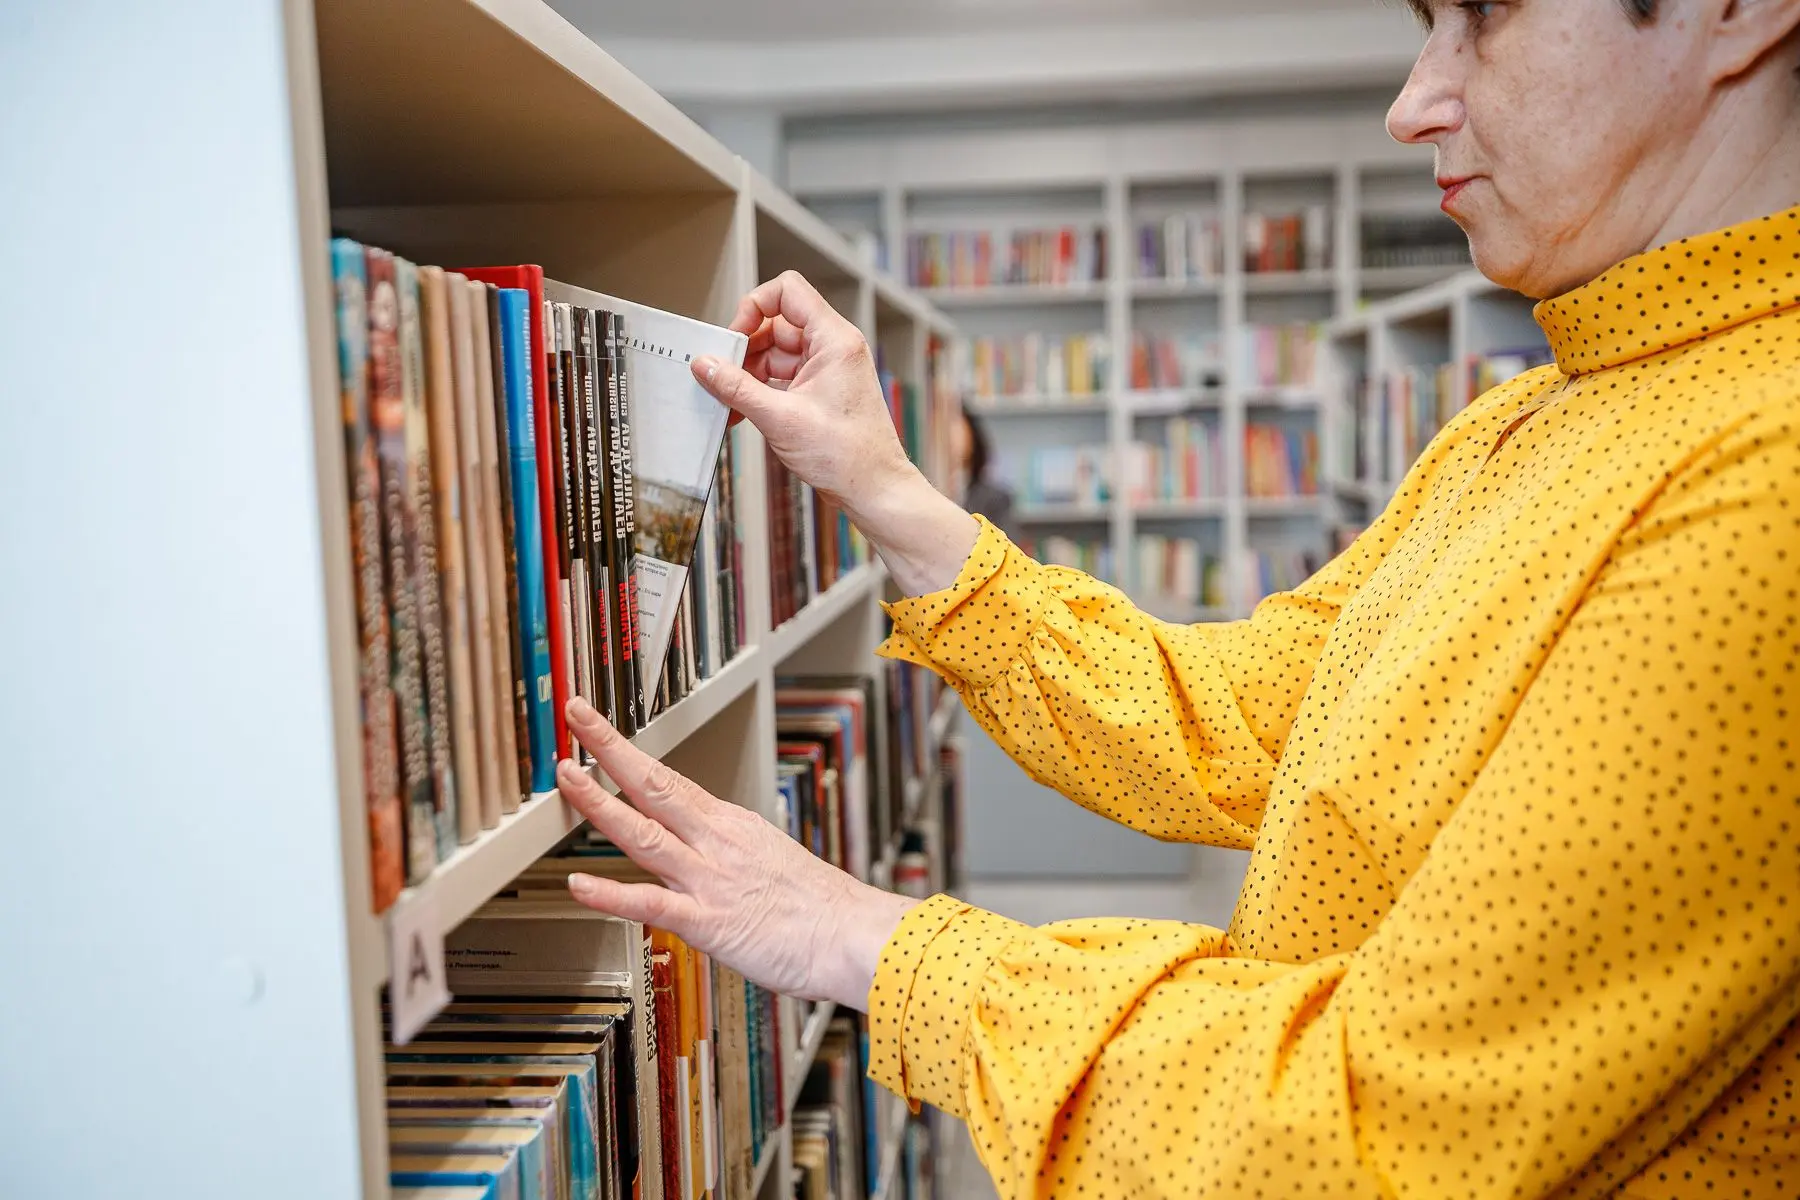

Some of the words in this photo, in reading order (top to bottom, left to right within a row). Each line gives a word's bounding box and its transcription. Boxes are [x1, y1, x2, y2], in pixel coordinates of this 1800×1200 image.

[586, 425, 602, 543] АБДУЛЛАЕВ
[609, 425, 626, 539] АБДУЛЛАЕВ
[621, 422, 635, 533] АБДУЛЛАЕВ
[643, 945, 654, 1062] БЛОКАДНАЯ
